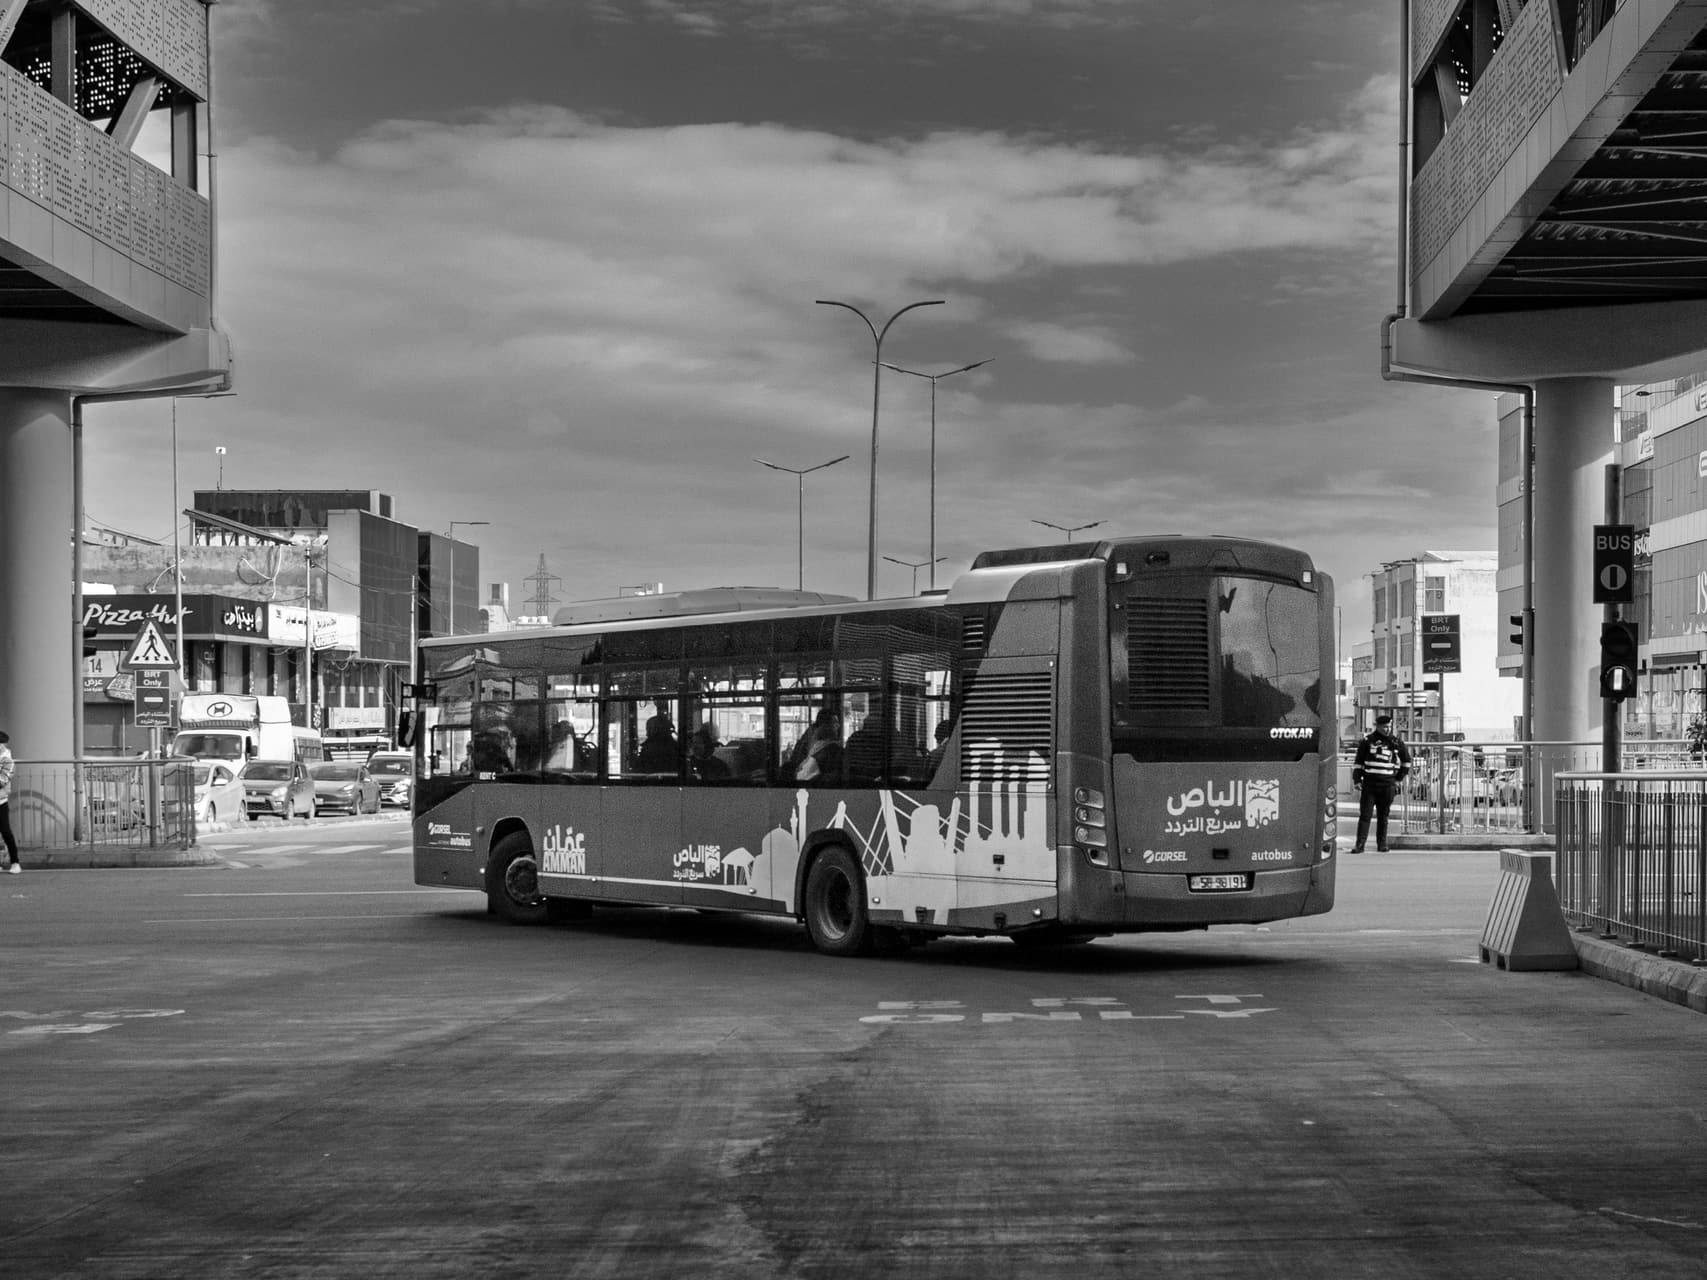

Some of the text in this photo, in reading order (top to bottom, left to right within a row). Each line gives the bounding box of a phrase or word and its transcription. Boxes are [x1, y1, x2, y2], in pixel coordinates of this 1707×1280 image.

[1597, 535, 1631, 550] BUS
[83, 603, 144, 626] Pizza
[1430, 625, 1450, 633] Only
[143, 679, 162, 688] Only
[1269, 727, 1313, 739] OTOKAR
[1166, 780, 1243, 816] الباص
[1165, 816, 1242, 836] سريع التردد
[543, 851, 586, 874] AMMAN
[673, 844, 705, 868] الباص
[1251, 849, 1293, 861] autobus
